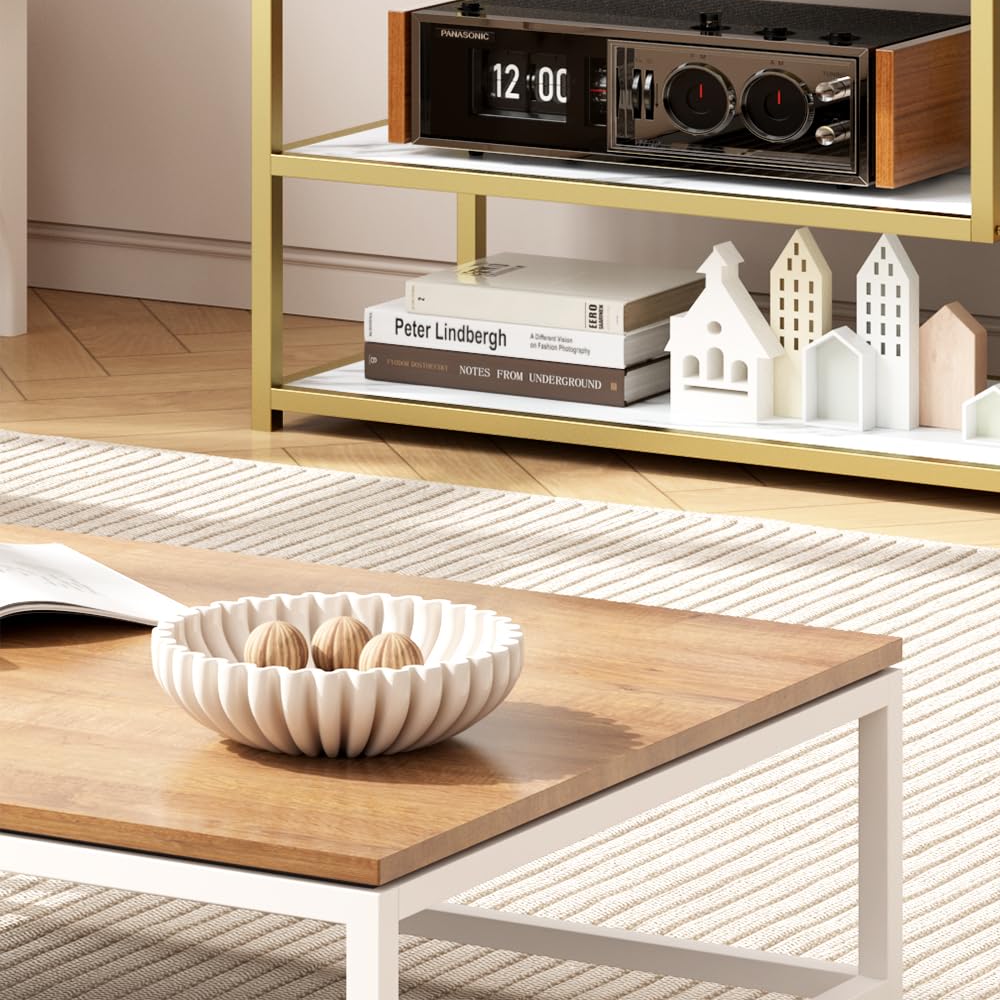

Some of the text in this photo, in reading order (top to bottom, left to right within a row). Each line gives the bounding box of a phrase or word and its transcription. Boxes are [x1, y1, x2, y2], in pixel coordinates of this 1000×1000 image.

[440, 29, 490, 41] PANASONIC
[588, 303, 598, 329] EERO
[395, 317, 431, 339] Peter
[435, 322, 507, 351] Lindbergh
[535, 333, 557, 342] Different
[538, 342, 557, 351] Fashion
[558, 344, 591, 356] Photography
[459, 365, 602, 390] NOTES FROM UNDERGROUND
